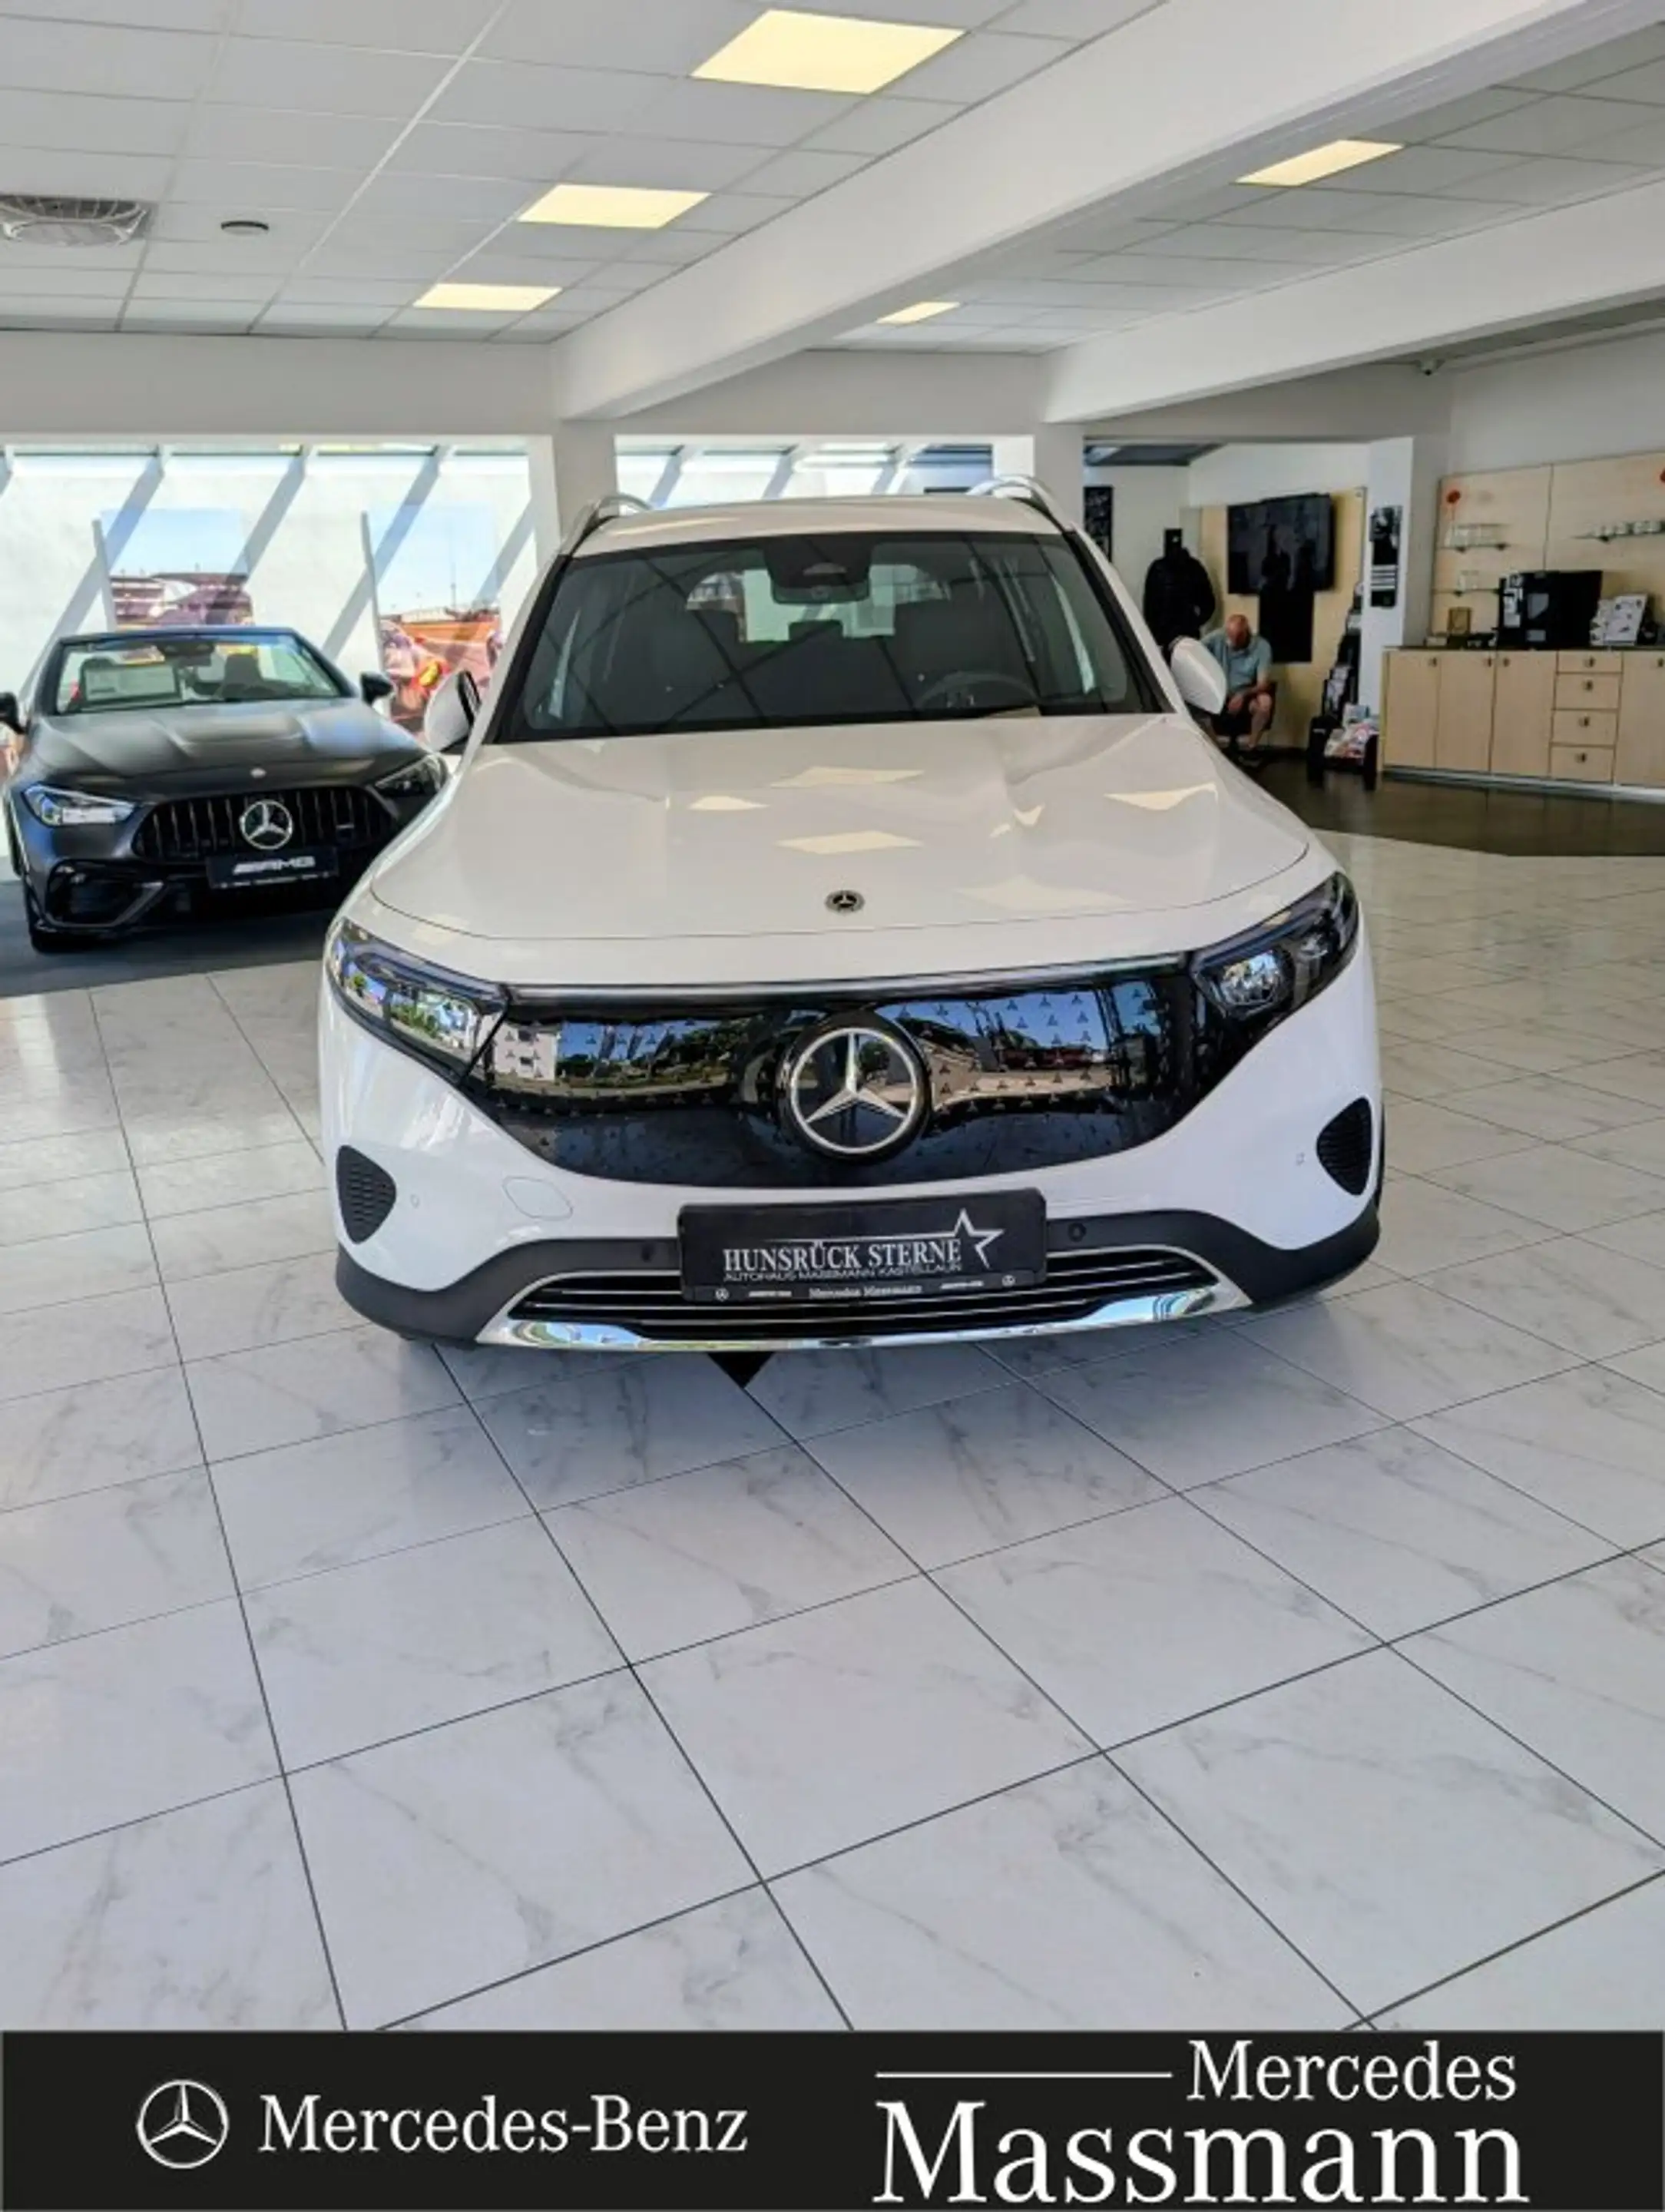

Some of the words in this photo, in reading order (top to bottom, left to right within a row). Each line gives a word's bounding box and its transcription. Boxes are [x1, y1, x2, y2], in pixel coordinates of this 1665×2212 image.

[723, 1240, 862, 1271] HUNSRÜCK
[868, 1238, 961, 1267] STERNE
[723, 1271, 796, 1282] AUTOHAUS
